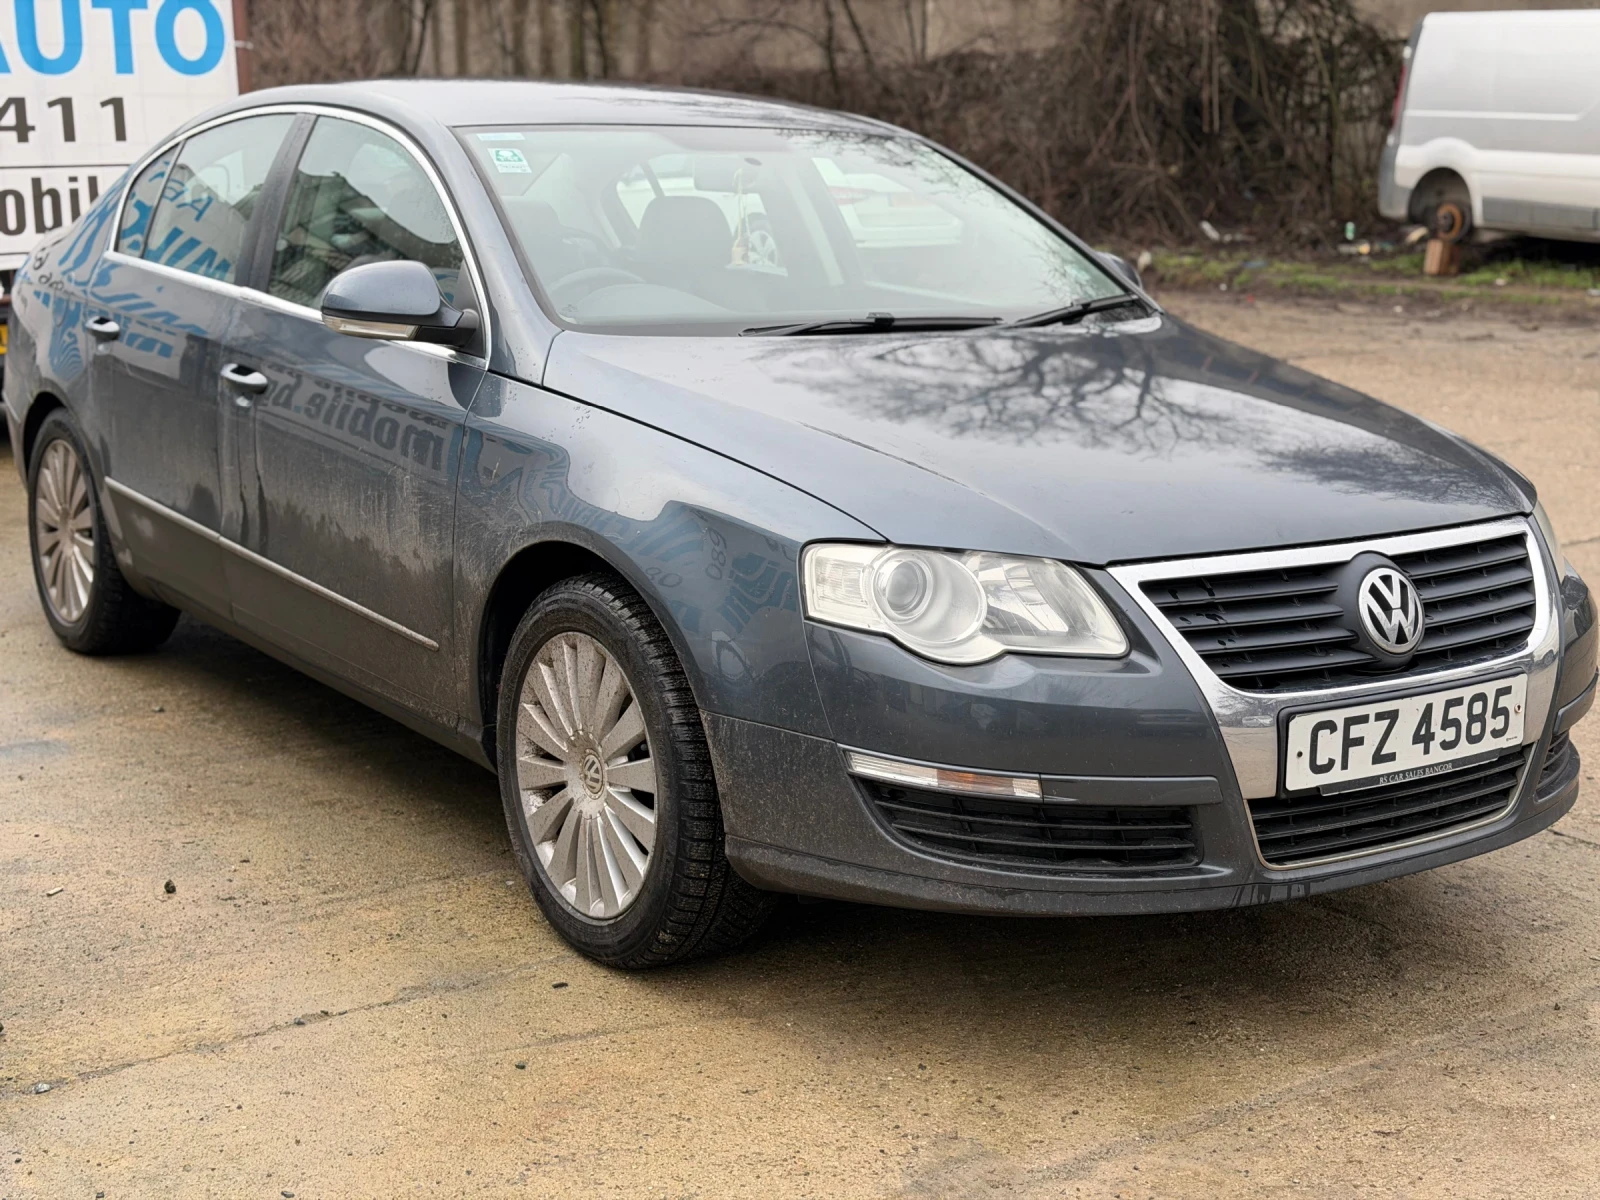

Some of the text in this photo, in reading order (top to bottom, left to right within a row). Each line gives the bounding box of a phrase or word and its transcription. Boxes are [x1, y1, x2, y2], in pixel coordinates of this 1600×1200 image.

[0, 0, 225, 76] UTO
[1308, 685, 1512, 775] CFZ 4585
[1389, 773, 1404, 783] CAR
[1405, 769, 1424, 779] SALES
[1425, 763, 1453, 775] BANGOR
